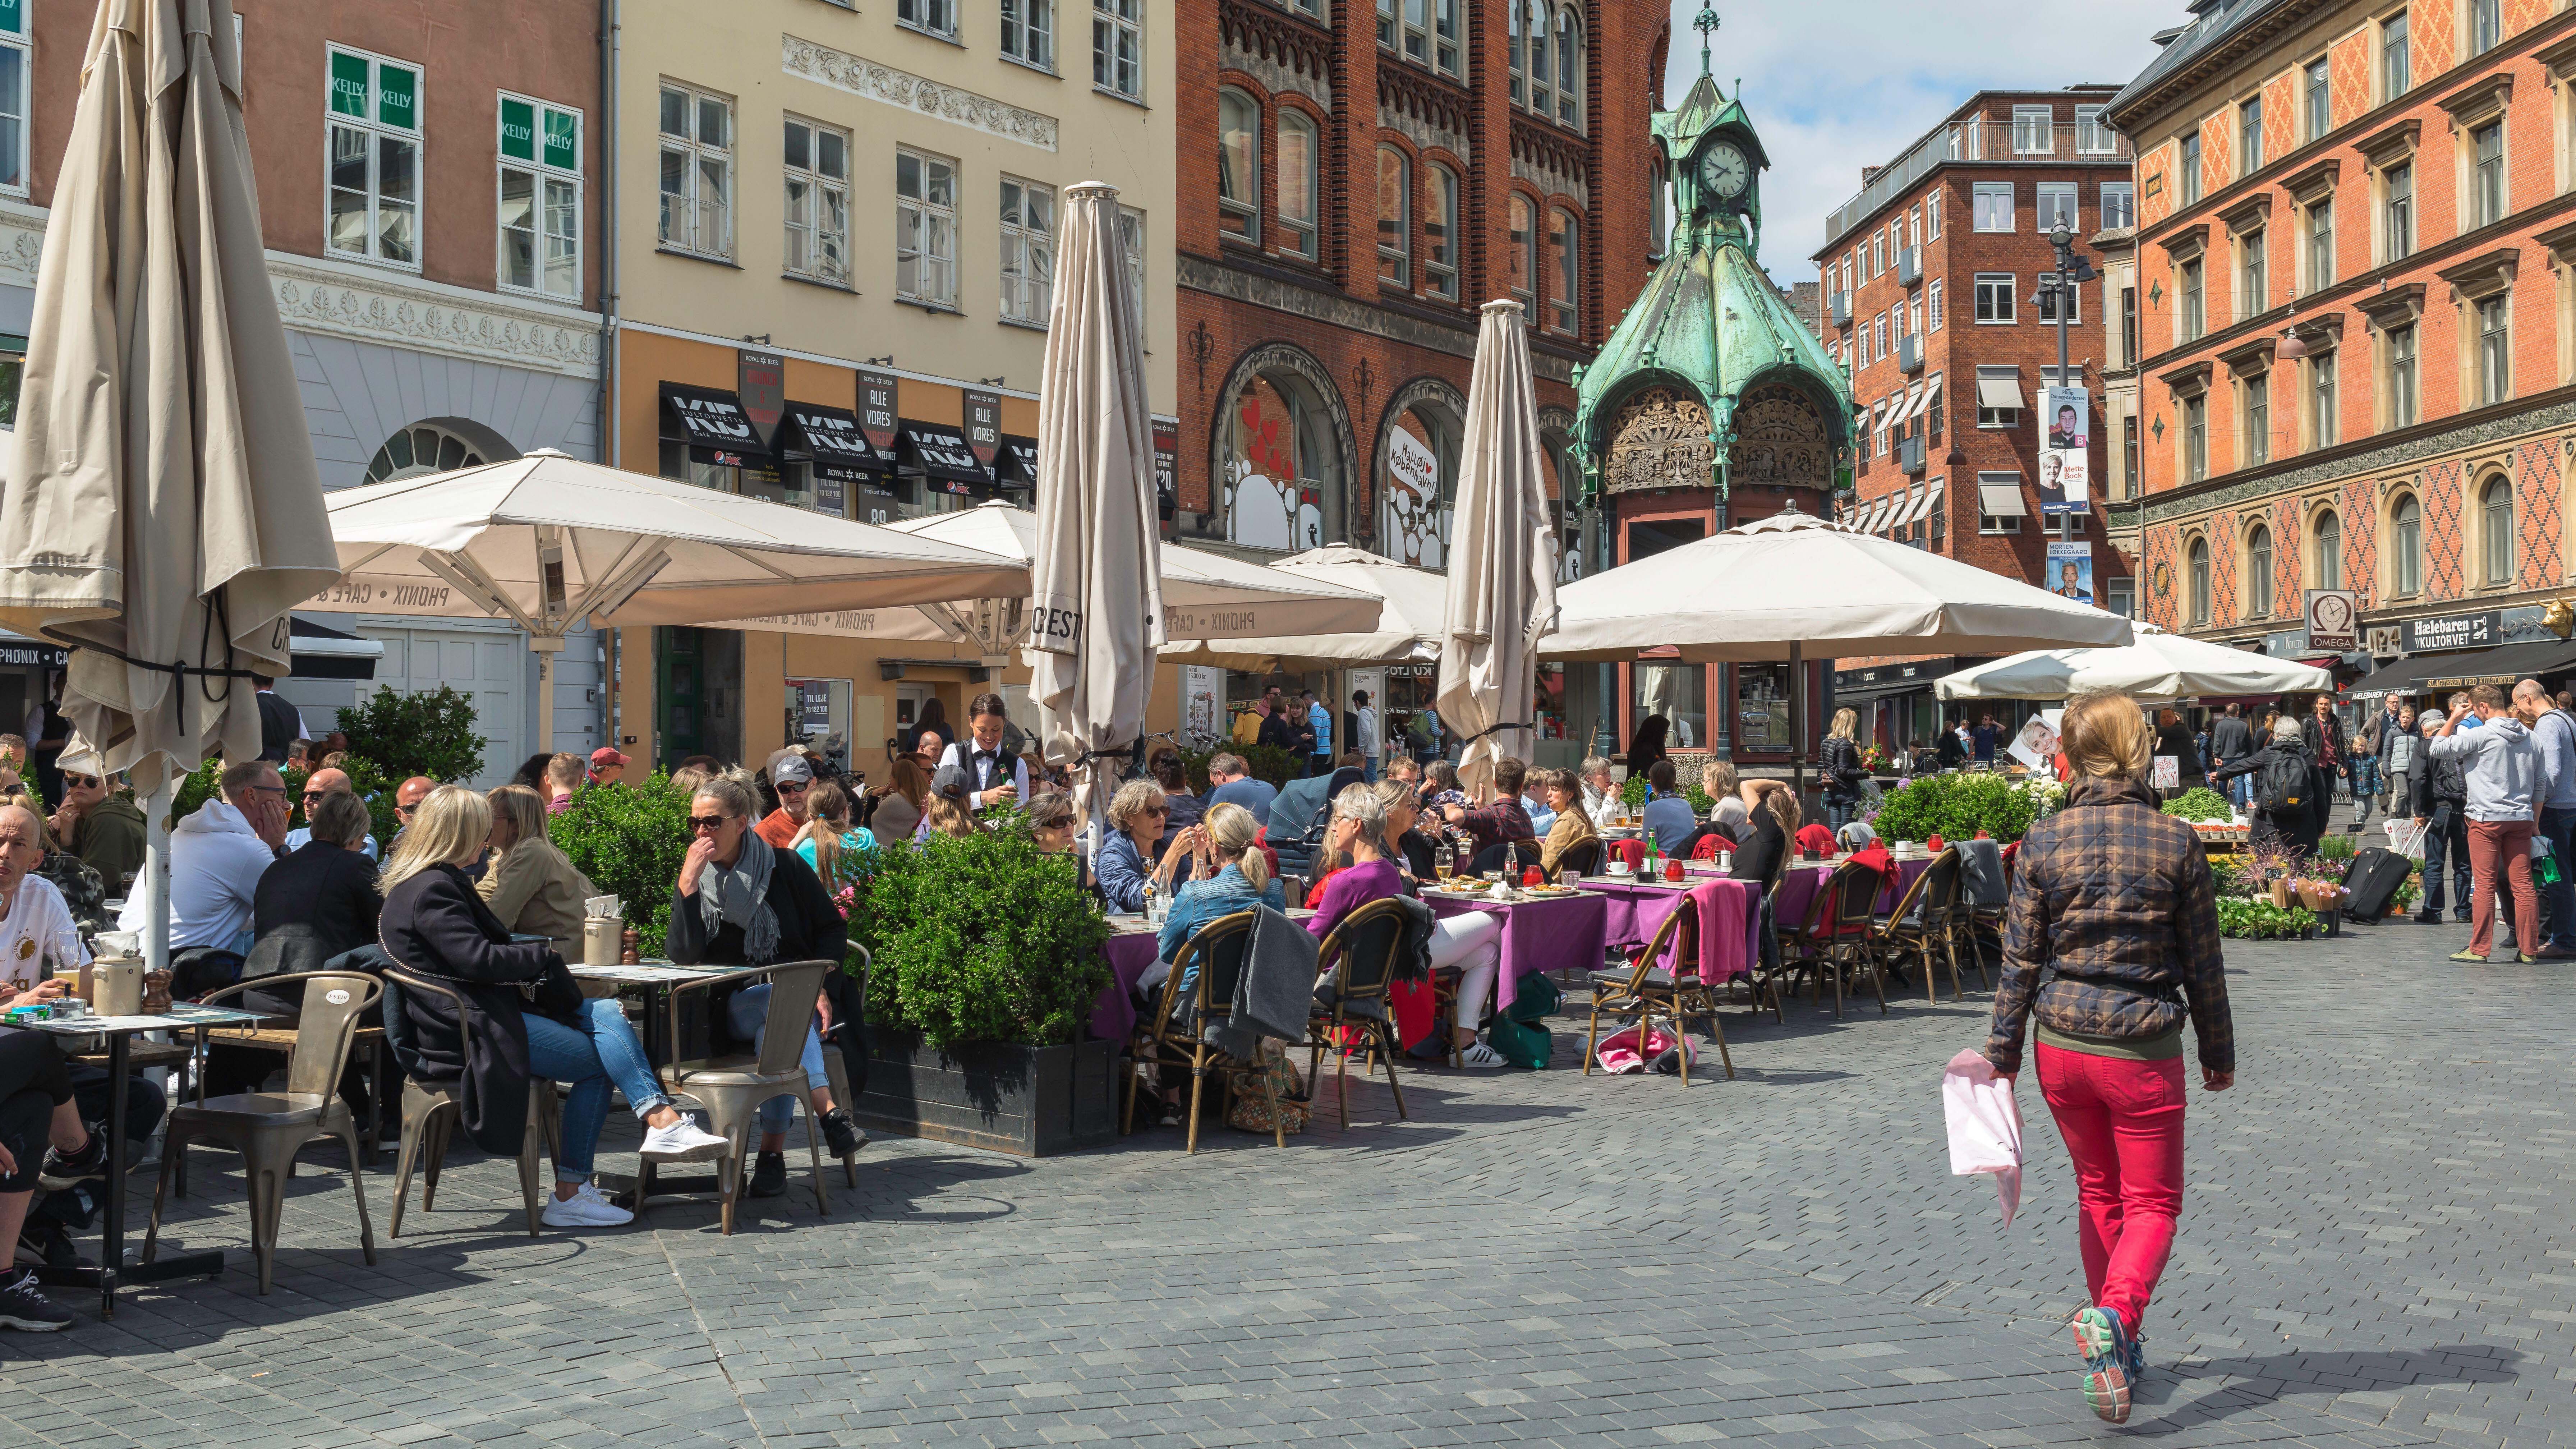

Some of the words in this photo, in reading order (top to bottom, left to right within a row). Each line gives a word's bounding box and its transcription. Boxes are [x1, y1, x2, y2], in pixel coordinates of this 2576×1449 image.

[332, 77, 364, 96] KELLY
[380, 89, 411, 108] KELLY
[502, 122, 530, 140] KELLY
[544, 132, 572, 150] KELLY
[870, 390, 887, 406] ALLE
[866, 409, 891, 427] VORES
[976, 407, 991, 423] ALLE
[718, 434, 756, 444] Restaurant
[972, 426, 995, 443] VORES
[2077, 436, 2084, 446] B
[837, 450, 872, 459] Restaurant
[1402, 442, 1426, 473] Halløj
[828, 469, 845, 477] ROYAL
[855, 472, 870, 480] BEER
[948, 465, 980, 473] Restaurant
[1390, 448, 1435, 493] København!
[2415, 619, 2469, 636] Hælebaren
[2314, 638, 2351, 647] OMEGA
[0, 649, 39, 664] PHØNIX
[1903, 667, 1915, 677] humac
[2427, 678, 2462, 688] SLAGTEREN
[2465, 677, 2477, 685] VED
[2479, 675, 2516, 685] KULTORVET
[815, 694, 827, 702] LEJE
